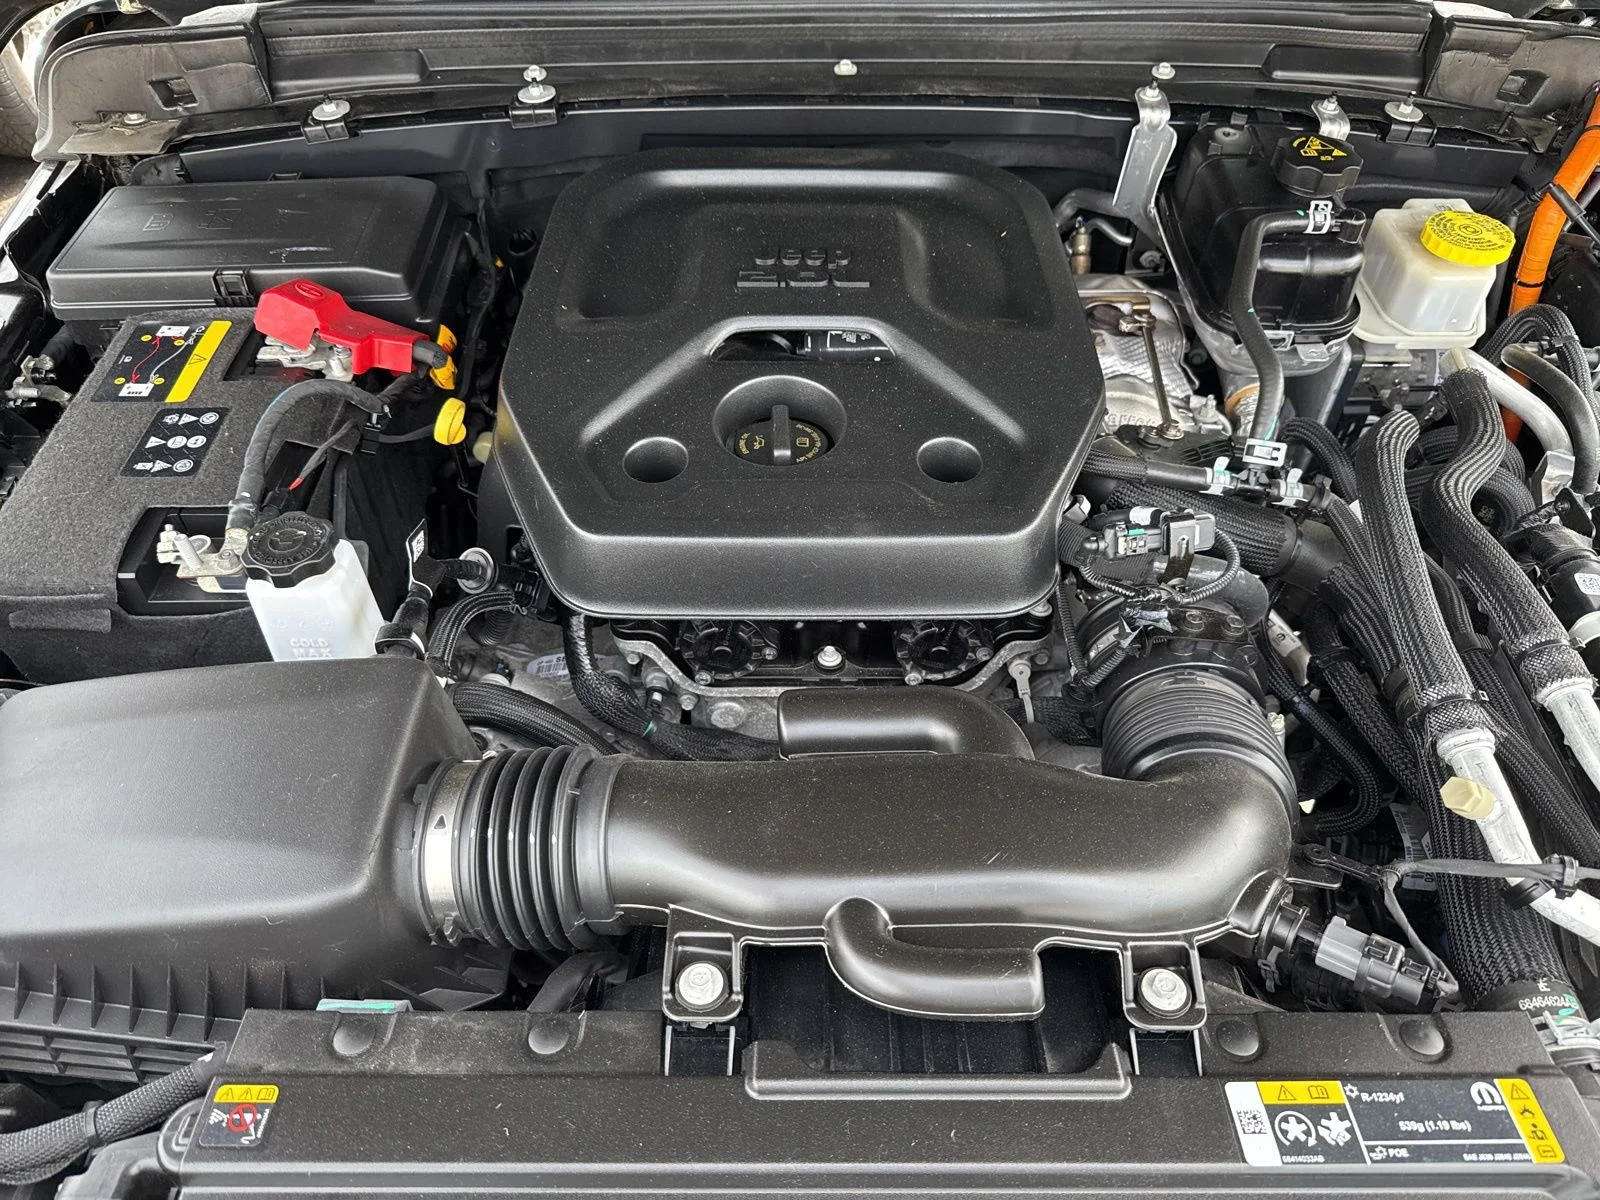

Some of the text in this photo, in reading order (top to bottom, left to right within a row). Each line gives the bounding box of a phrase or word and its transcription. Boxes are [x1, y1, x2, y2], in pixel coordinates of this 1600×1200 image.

[755, 248, 850, 270] Jeep
[290, 637, 329, 648] COLD
[292, 648, 333, 659] MAX
[1388, 1148, 1410, 1158] POE
